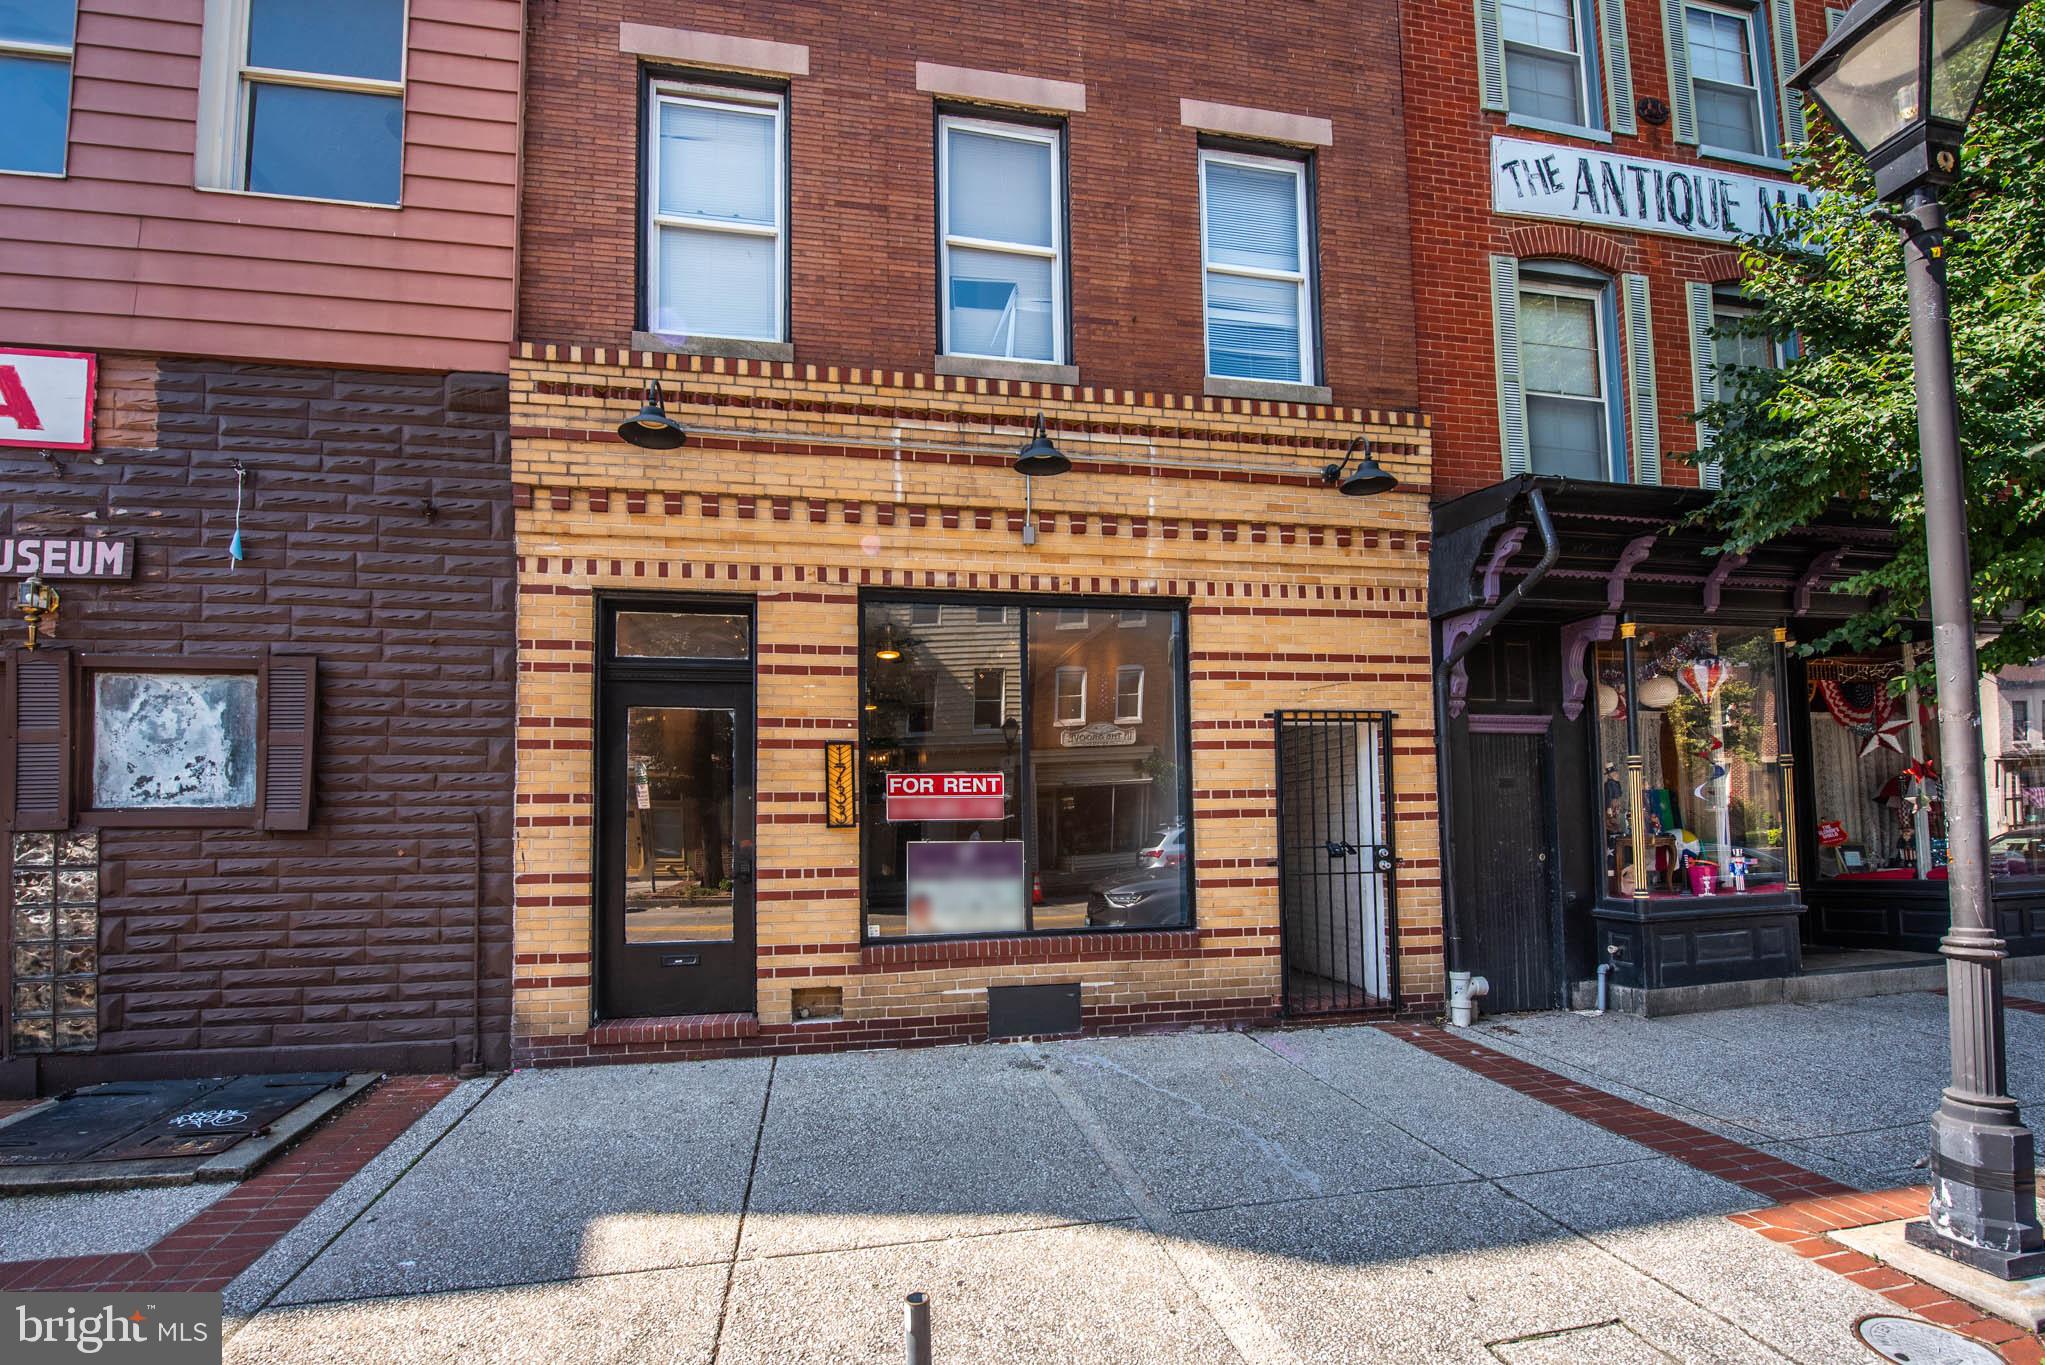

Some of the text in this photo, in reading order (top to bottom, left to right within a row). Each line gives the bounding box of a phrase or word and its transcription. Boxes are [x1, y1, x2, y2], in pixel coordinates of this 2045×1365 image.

[1500, 153, 1565, 198] THE
[1572, 157, 1743, 233] ANTIQUE
[833, 744, 848, 825] 1733
[889, 777, 1001, 794] FOR RENT
